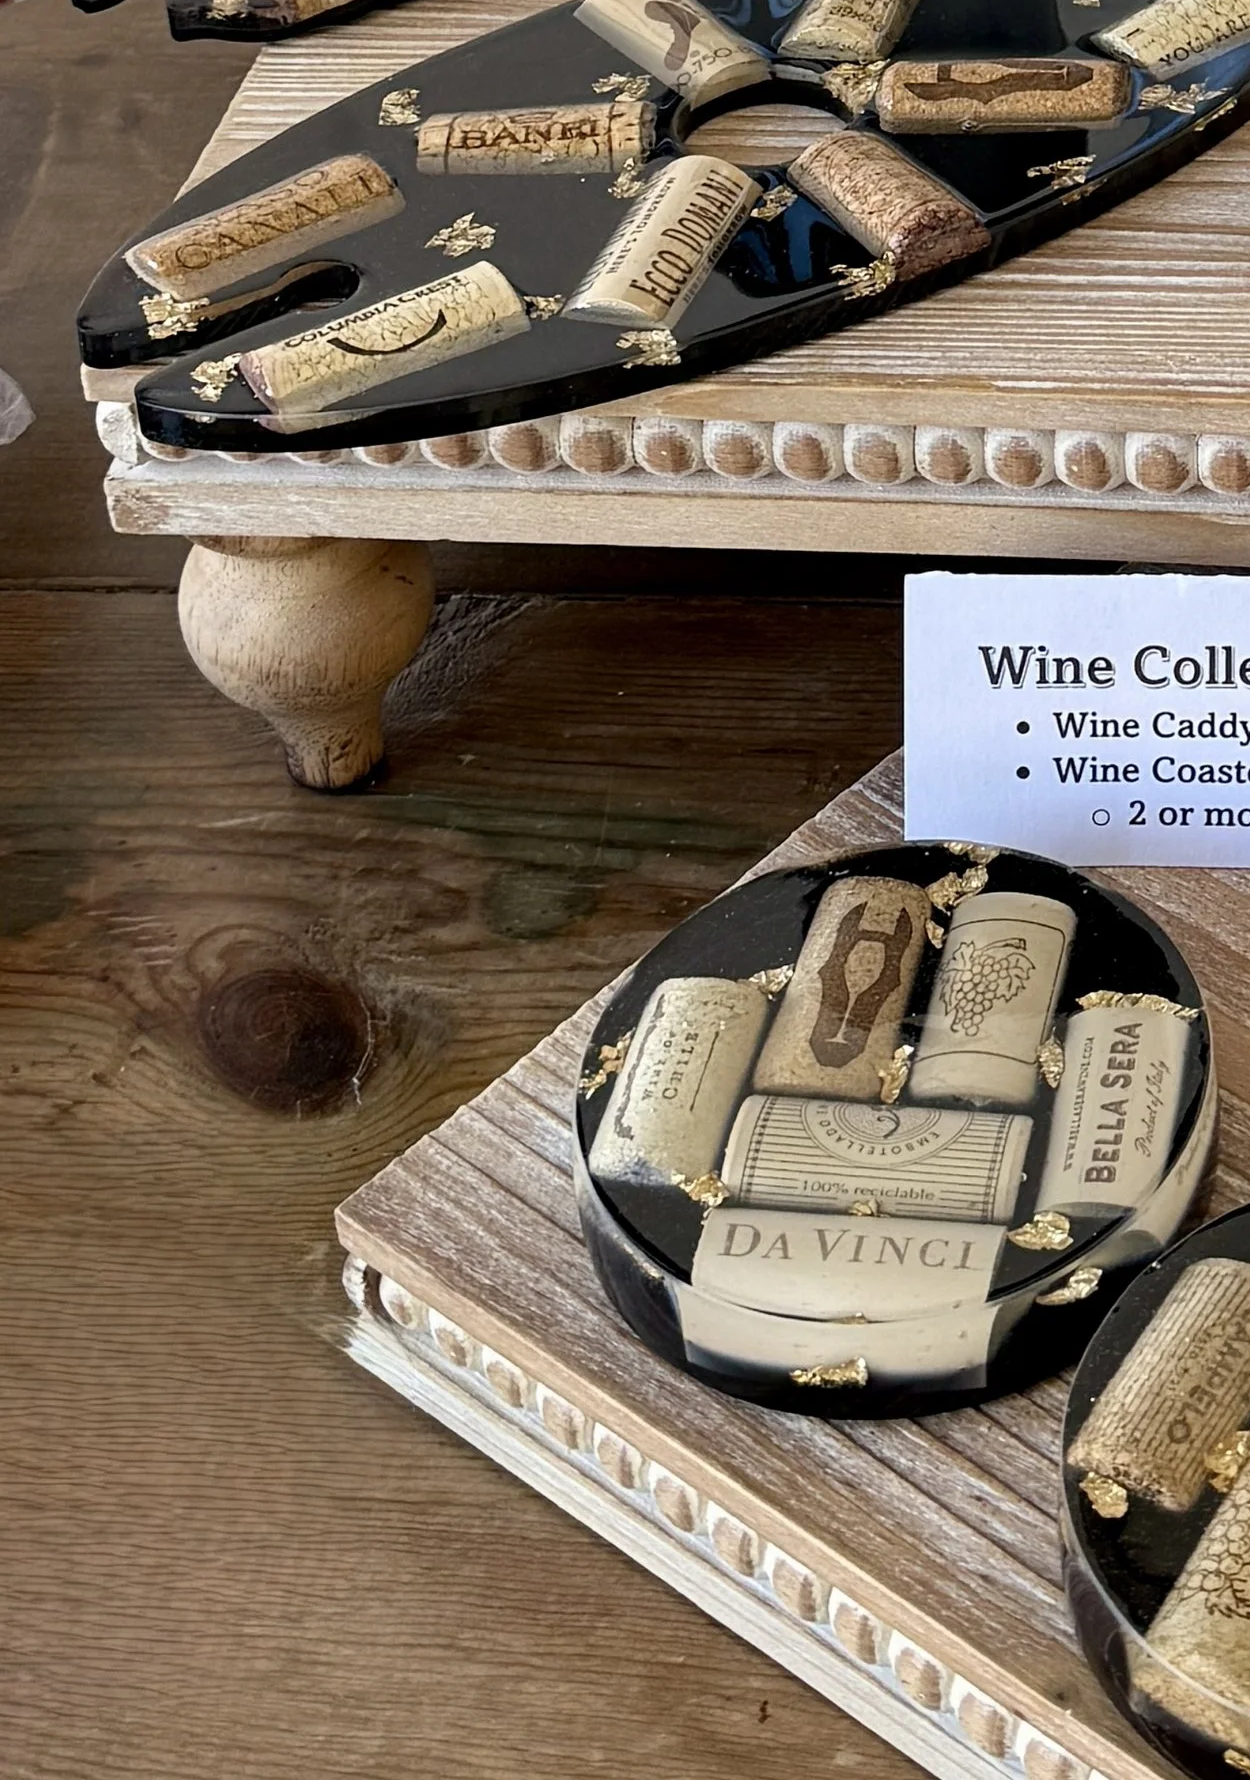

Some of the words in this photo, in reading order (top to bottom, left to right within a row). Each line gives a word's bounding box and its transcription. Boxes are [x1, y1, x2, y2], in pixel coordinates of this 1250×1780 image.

[1159, 36, 1205, 67] YOU
[660, 169, 744, 255] DOMANI
[629, 250, 694, 308] ECCO
[285, 299, 397, 349] COLUMBIA
[398, 274, 461, 303] CREST
[978, 645, 1116, 688] Wine
[1053, 712, 1140, 739] Wine
[1053, 757, 1140, 784] Wine
[1128, 801, 1147, 826] 2
[1159, 807, 1194, 827] or
[662, 1031, 700, 1100] CHILE
[1100, 1023, 1143, 1089] SERA
[1146, 1059, 1172, 1093] Italy
[1146, 1088, 1164, 1106] of
[819, 1119, 940, 1156] EMBOTELLADO
[1084, 1099, 1129, 1183] BELLA
[1134, 1105, 1158, 1157] Product
[802, 1180, 849, 1195] 100%
[854, 1184, 936, 1201] reciclable
[718, 1223, 793, 1261] DA
[813, 1227, 982, 1271] VINCI
